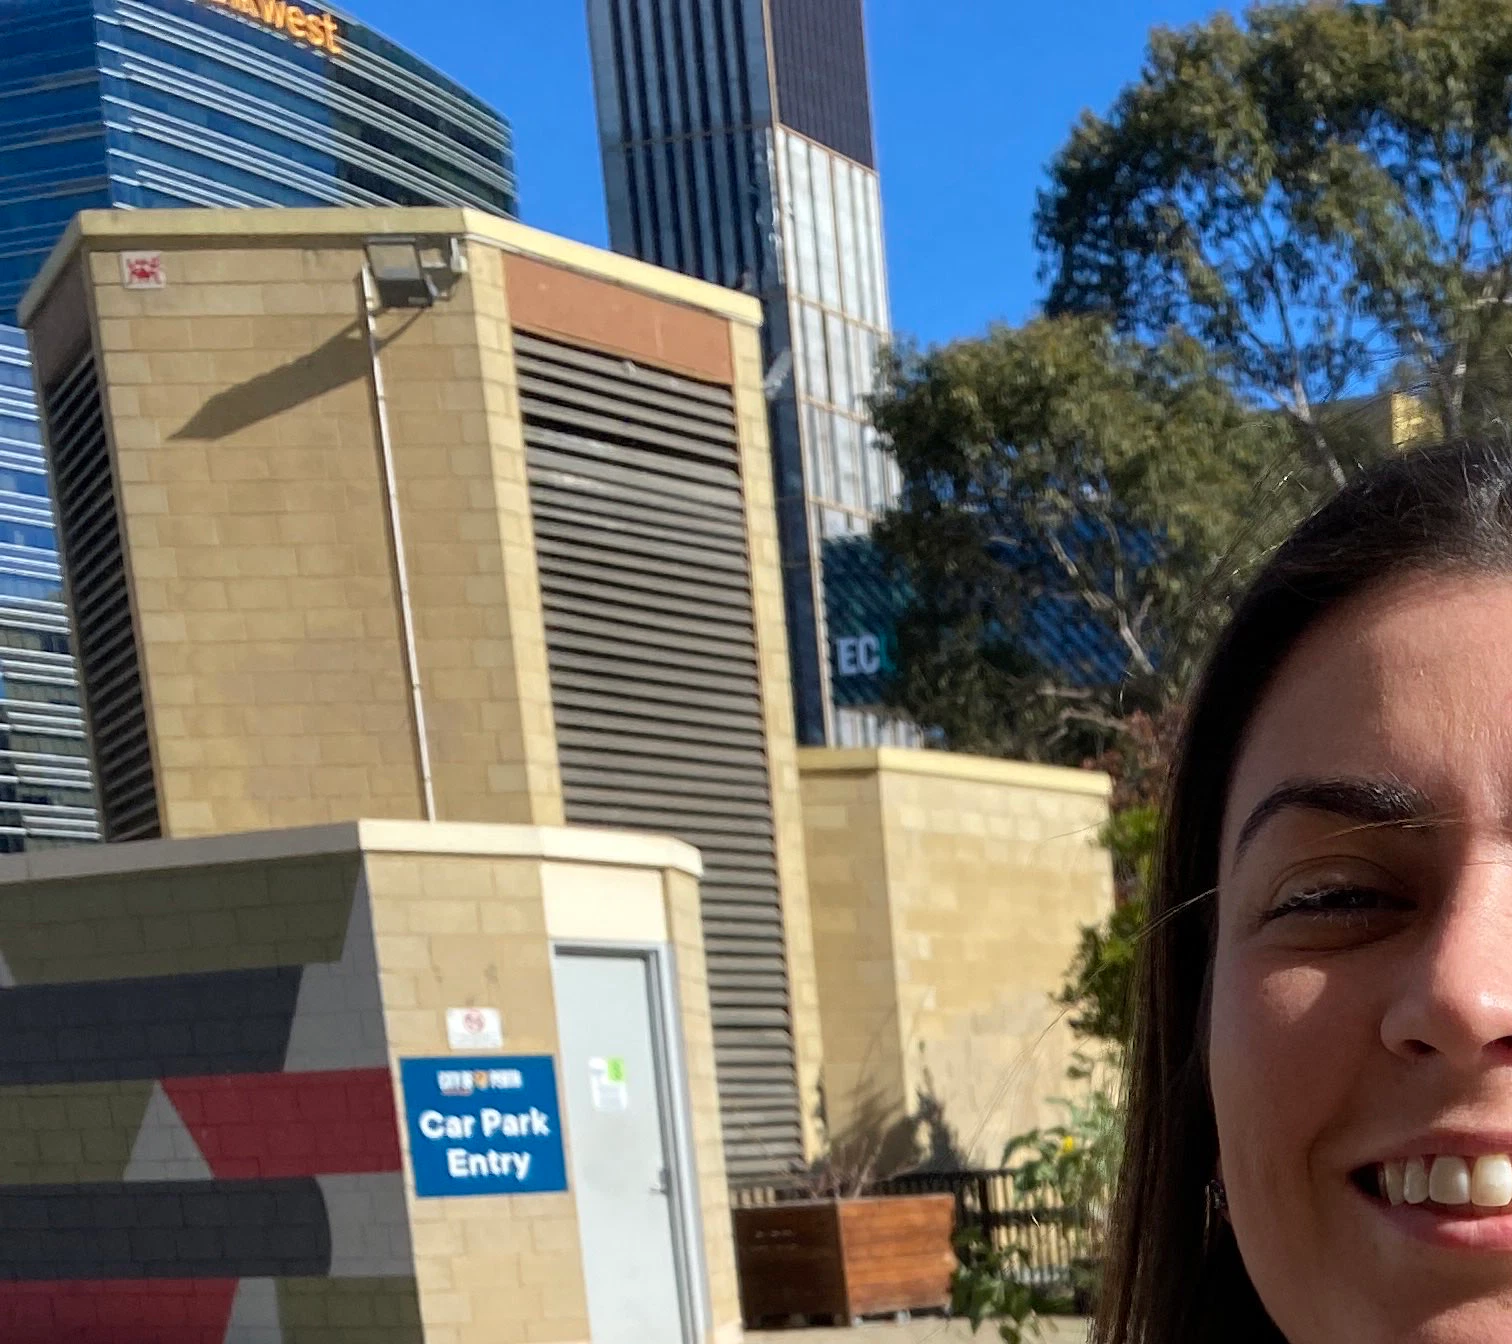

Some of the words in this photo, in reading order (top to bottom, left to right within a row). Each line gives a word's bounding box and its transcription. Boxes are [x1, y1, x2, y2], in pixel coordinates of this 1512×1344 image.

[418, 1109, 476, 1140] Car
[480, 1106, 551, 1138] Park
[446, 1147, 532, 1181] Entry
